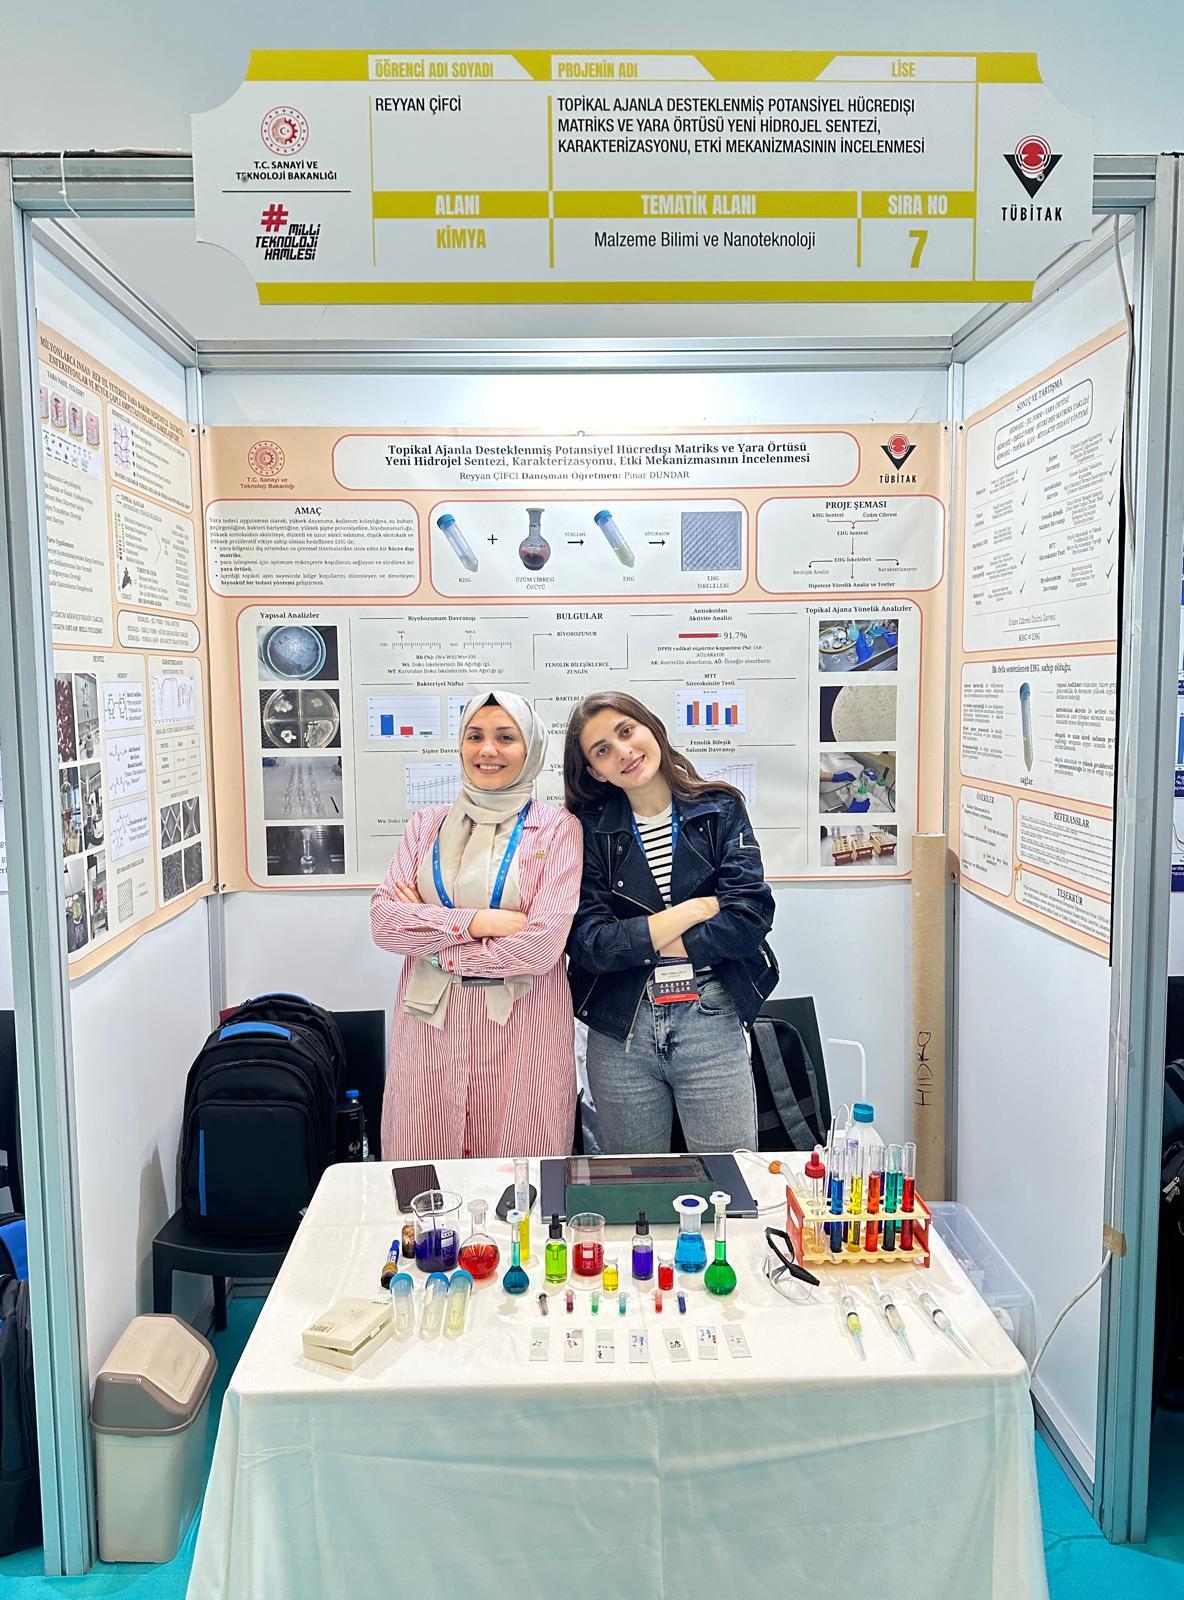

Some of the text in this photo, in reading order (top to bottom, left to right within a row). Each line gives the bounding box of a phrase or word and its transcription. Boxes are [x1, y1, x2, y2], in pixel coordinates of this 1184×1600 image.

[375, 58, 494, 78] ÖĞRENCİ ADI SOYADI
[558, 60, 638, 78] PROJENİN ADI
[892, 59, 916, 78] LİSE
[376, 94, 462, 115] REYYAN ÇİFCİ
[558, 94, 915, 115] TOPİKAL AJANLA DESTEKLENMİŞ POTANSİYEL HÜCREDIŞI
[558, 116, 880, 135] MATRİKS VE YARA ÖRTÜSÜ YENİ HİDROJEL SENTEZİ,
[558, 136, 925, 156] KARAKTERİZASYONU, ETKİ MEKANİZMASININ İNCELENMESİ
[254, 161, 270, 169] T.C.
[272, 160, 304, 169] SANAYİ
[288, 170, 337, 180] BAKANLIĞI
[436, 195, 480, 216] ALANI
[642, 190, 756, 214] TEMATİK ALANI
[888, 194, 948, 215] SIRA NO
[1002, 203, 1062, 221] TÜBİTAK
[436, 224, 486, 248] KİMYA
[594, 231, 816, 250] Malzeme Bilimi ve Nanoteknoloji
[908, 230, 928, 268] 7
[388, 444, 432, 457] Topikal
[435, 445, 472, 457] Ajanla
[476, 445, 552, 457] Desteklenmiş
[556, 445, 614, 456] Potansiyel
[617, 444, 672, 456] Hücredışı
[674, 444, 718, 454] Matriks
[738, 443, 764, 453] Yara
[767, 442, 806, 452] Örtüsü
[385, 452, 810, 468] Yeni Hidrojel Sentezi, Karakterizasyonu, Etki Mekanizmasının İncelenmesi
[460, 472, 490, 481] Reyyan
[880, 474, 916, 484] TÜBİTAK
[294, 507, 322, 516] AMAÇ
[826, 500, 887, 510] PROJE ŞEMASI
[260, 612, 286, 620] Yapısal
[805, 607, 831, 615] Topikal
[832, 606, 852, 615] Ajana
[1054, 812, 1090, 828] REFERANSLAR
[1057, 888, 1084, 905] TEŞEKKÜR
